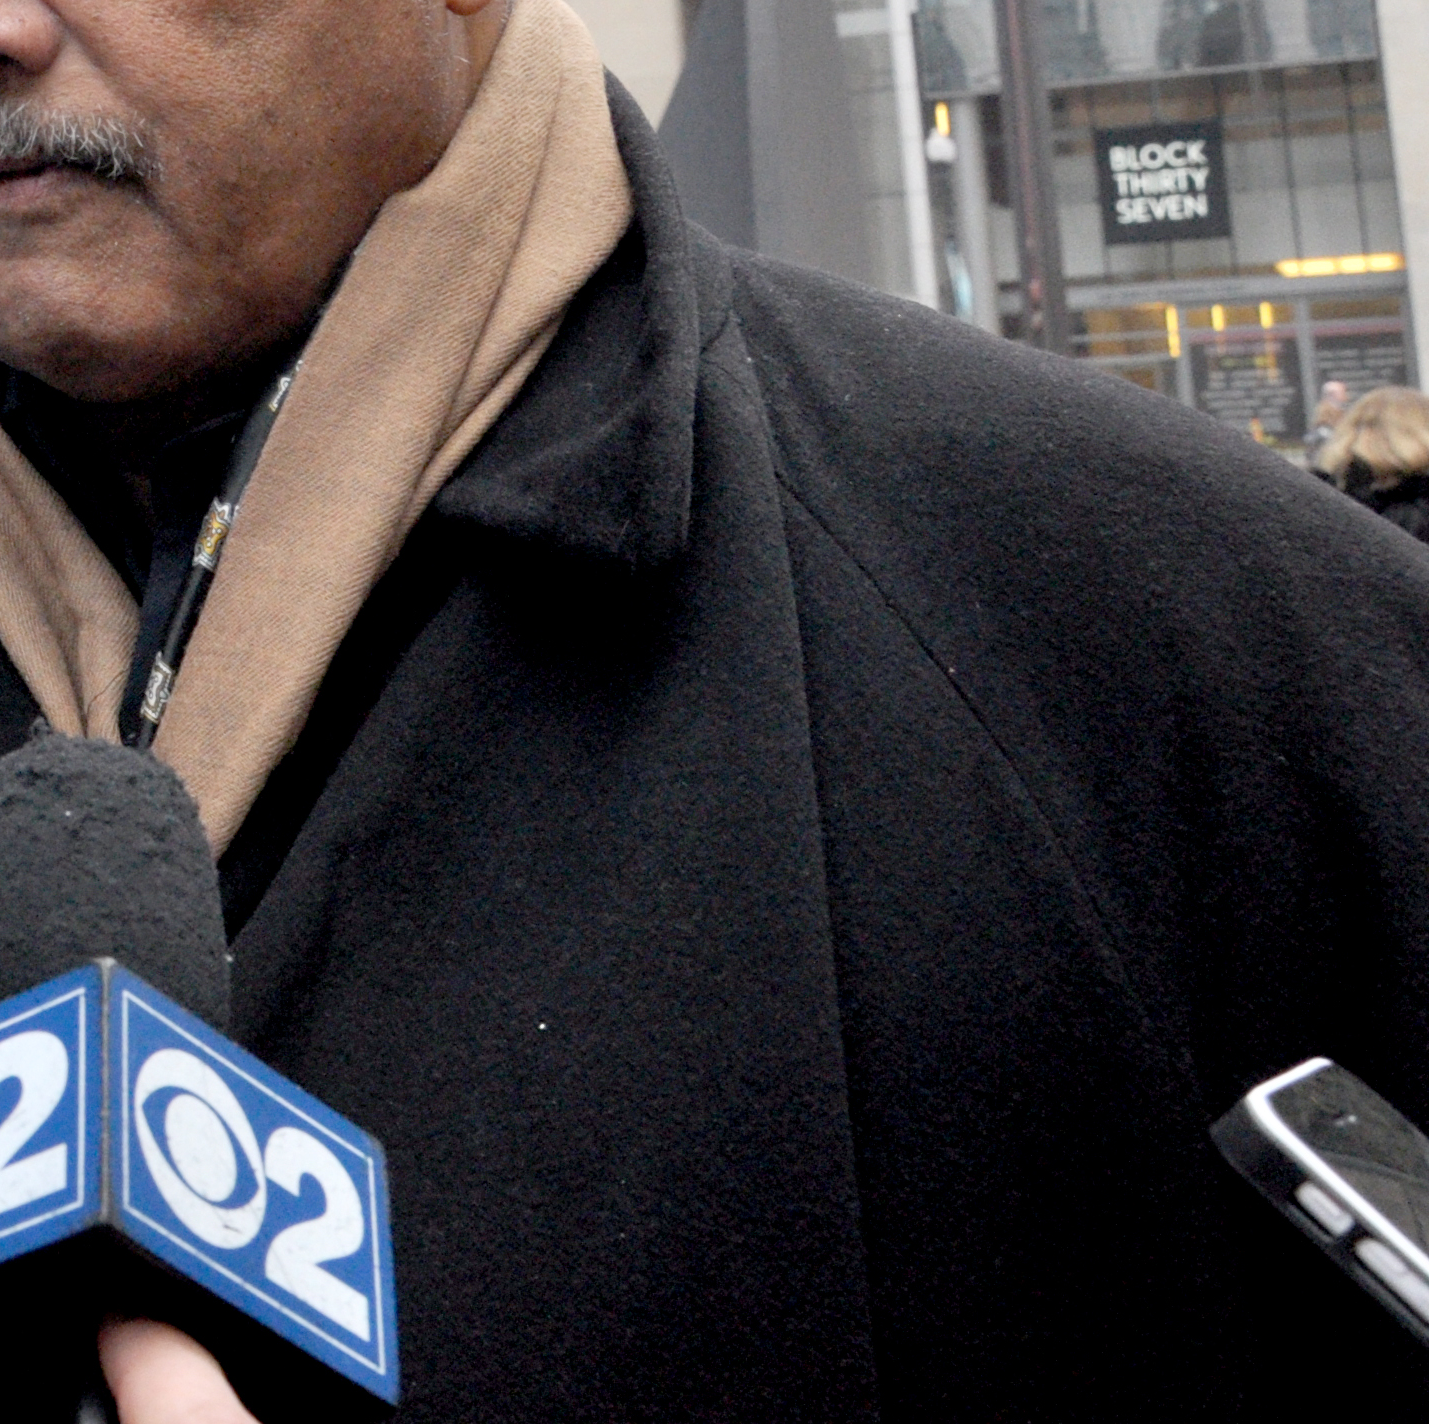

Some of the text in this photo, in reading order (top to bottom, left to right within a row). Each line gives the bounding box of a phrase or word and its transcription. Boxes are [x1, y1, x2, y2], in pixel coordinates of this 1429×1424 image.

[1109, 140, 1208, 172] BLOCK
[1113, 167, 1210, 196] THIRTY
[1116, 193, 1208, 224] SEVEN
